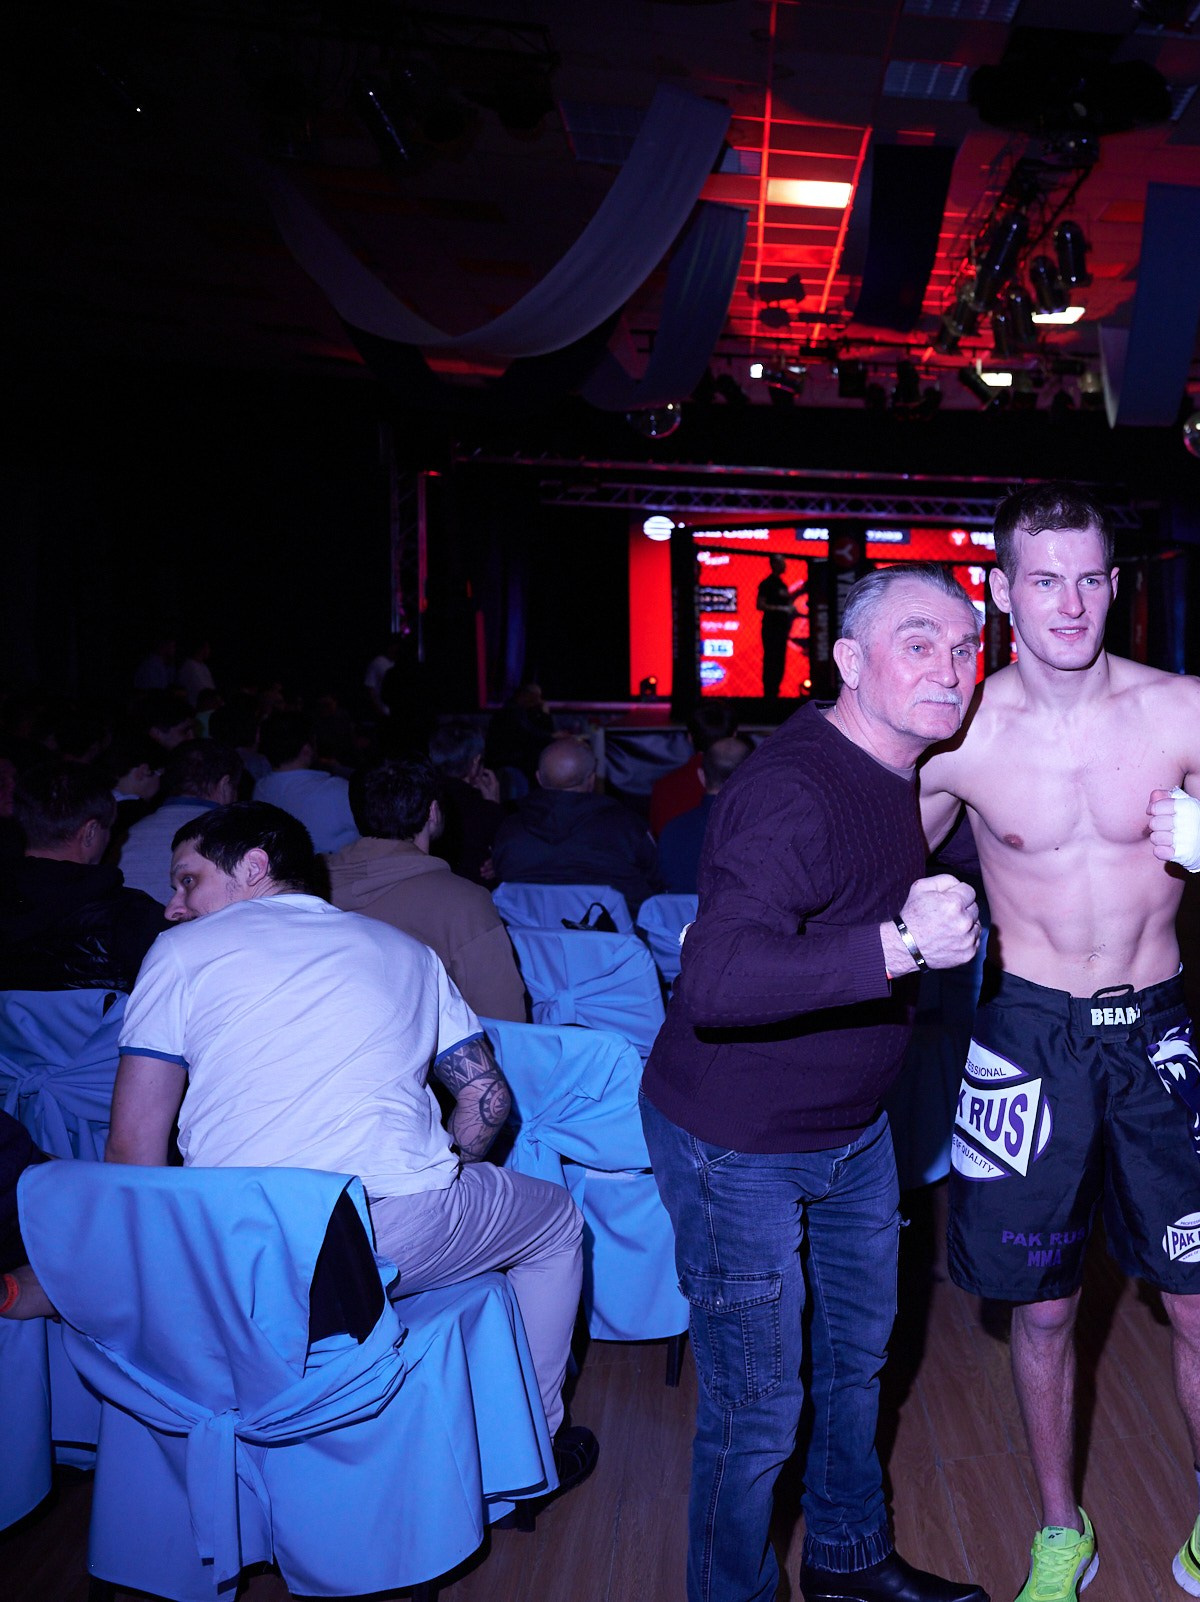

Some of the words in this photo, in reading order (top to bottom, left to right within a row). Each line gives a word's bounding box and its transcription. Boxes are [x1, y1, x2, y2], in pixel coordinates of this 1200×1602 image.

[968, 1093, 1028, 1158] RUS
[961, 1144, 994, 1173] QUALITY
[1001, 1230, 1043, 1247] PAK
[1171, 1231, 1195, 1255] PAK
[1027, 1248, 1062, 1267] MMA
